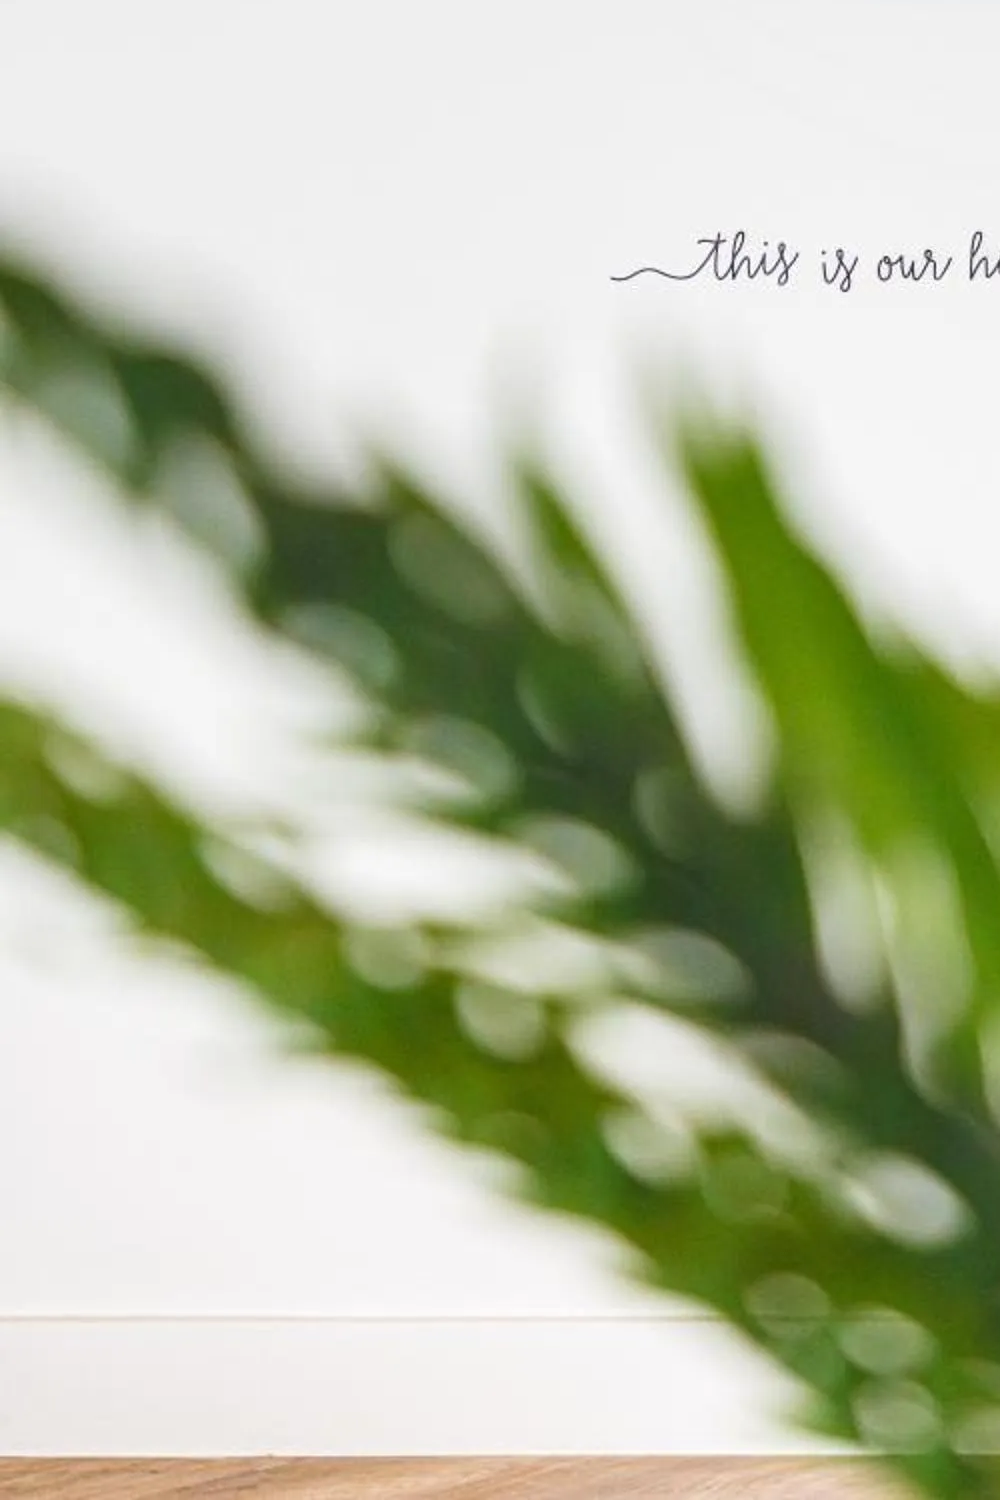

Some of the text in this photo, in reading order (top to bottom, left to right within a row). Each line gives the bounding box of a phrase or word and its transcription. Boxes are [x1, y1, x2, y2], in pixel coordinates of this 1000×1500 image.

[676, 231, 799, 284] this
[821, 248, 859, 293] is
[877, 249, 953, 281] our
